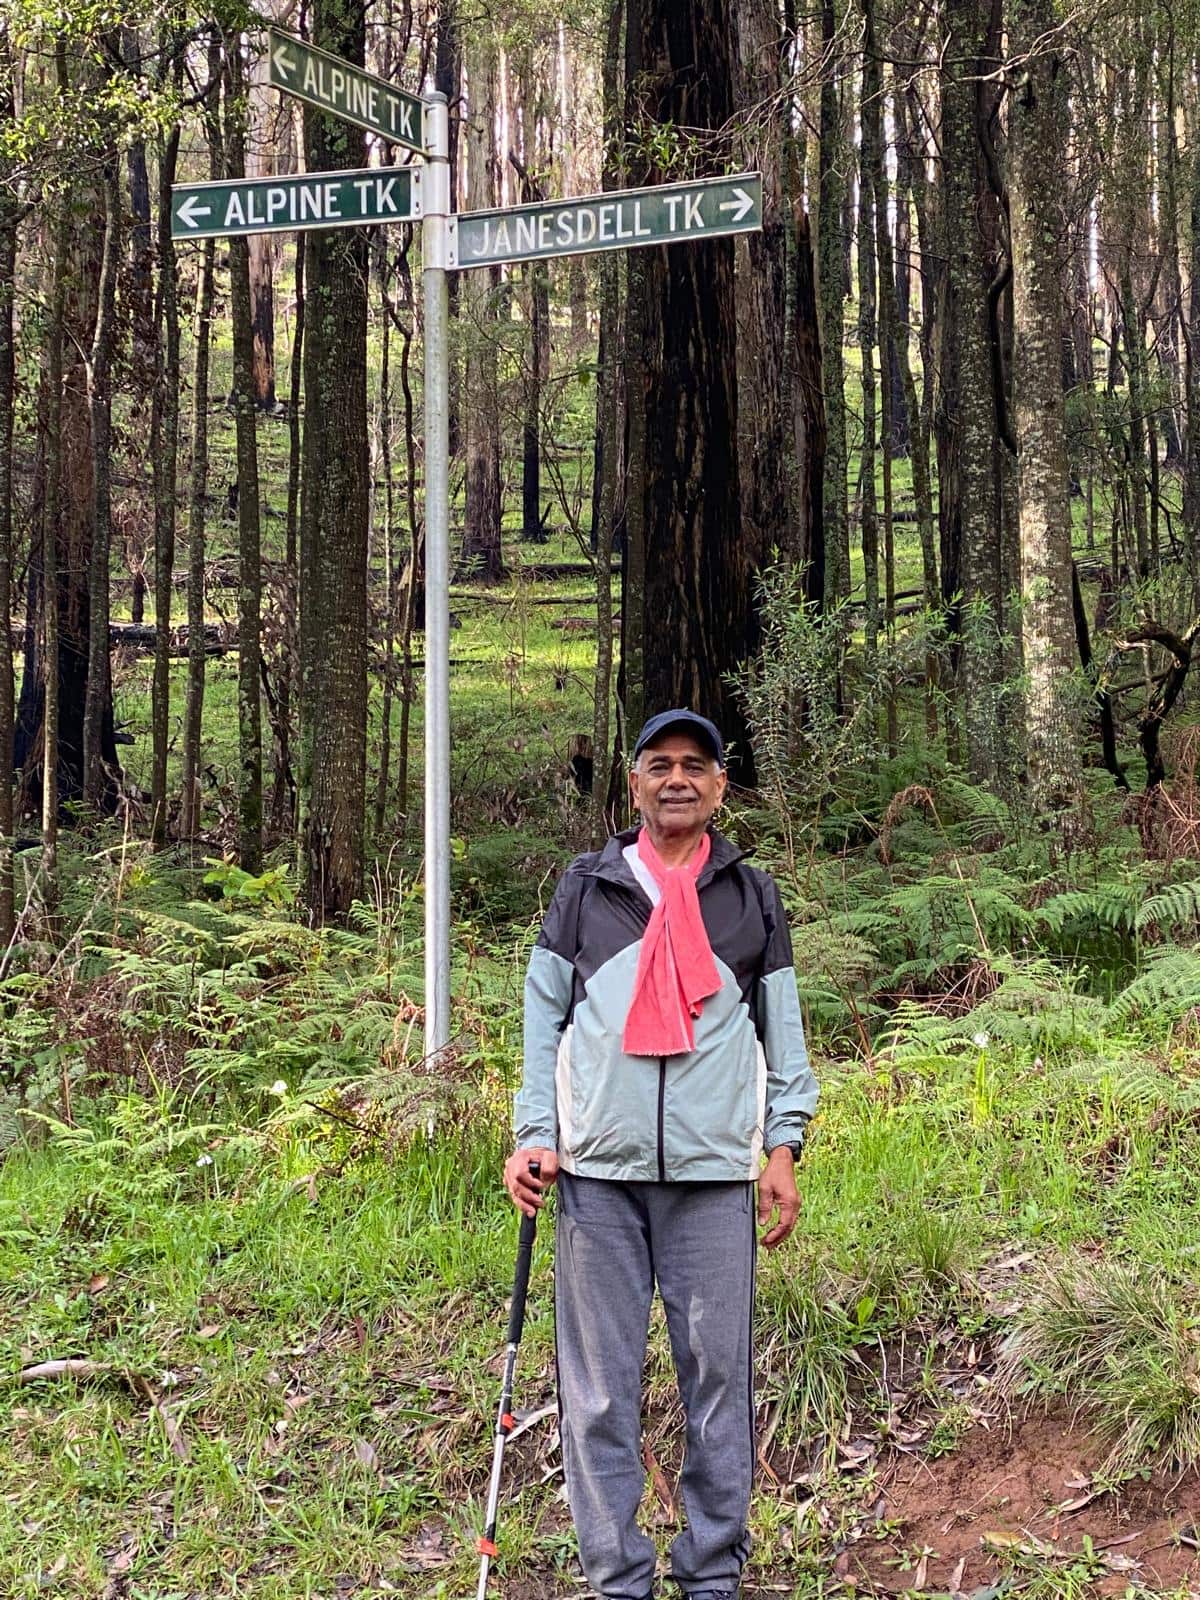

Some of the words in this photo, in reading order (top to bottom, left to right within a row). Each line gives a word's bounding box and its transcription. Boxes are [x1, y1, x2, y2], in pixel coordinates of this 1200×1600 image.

[303, 56, 380, 123] ALPINE
[386, 94, 414, 139] TK
[223, 183, 341, 226] ALPINE
[354, 177, 397, 215] TK
[472, 200, 651, 257] JANESDELL
[663, 192, 705, 232] TK
